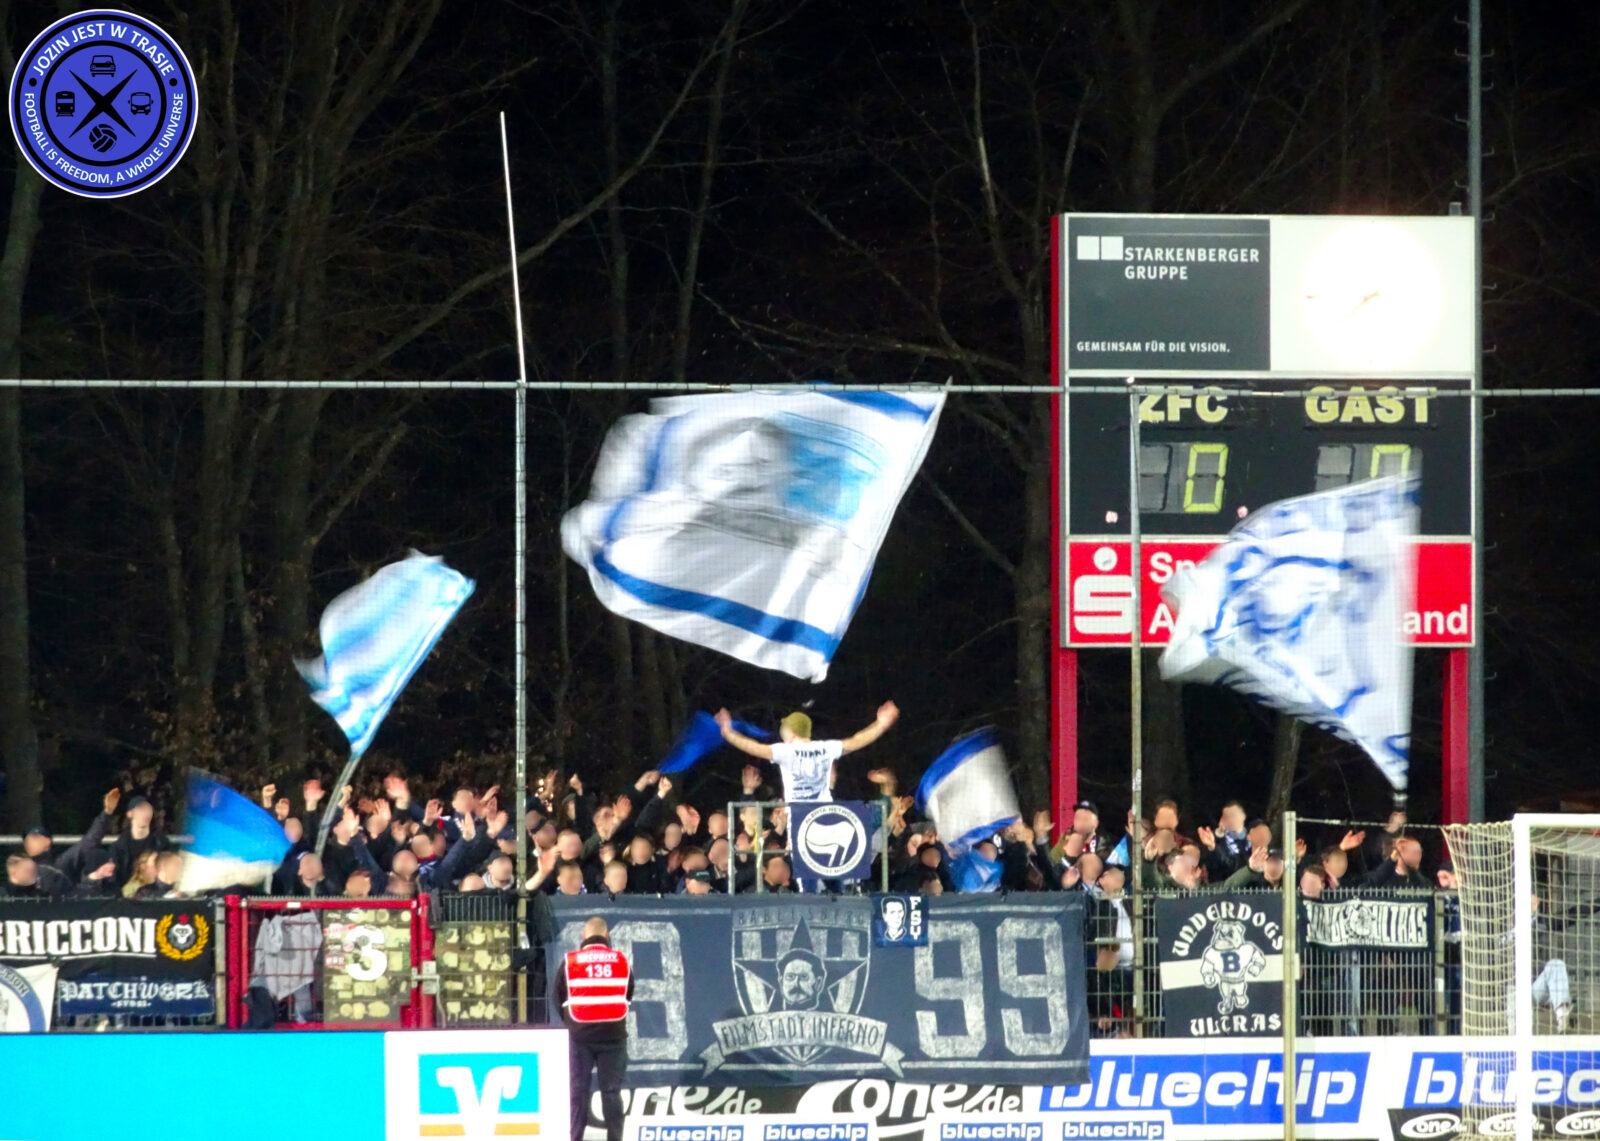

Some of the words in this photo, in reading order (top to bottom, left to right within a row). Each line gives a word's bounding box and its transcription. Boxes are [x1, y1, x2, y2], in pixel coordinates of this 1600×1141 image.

[1124, 247, 1260, 264] STARKENBERGER
[1124, 265, 1188, 280] GRUPPE
[1077, 341, 1142, 352] GEMEINSAM
[1145, 340, 1166, 353] FÜR
[1169, 342, 1186, 353] DIE
[1189, 342, 1231, 353] VISION.
[1136, 386, 1228, 424] ZFC
[1304, 385, 1438, 424] GAST
[1184, 443, 1229, 513] 0
[1402, 603, 1468, 635] and
[0, 917, 158, 955] RICCONI
[1172, 901, 1283, 957] UNDERDOGS
[347, 925, 387, 981] 3
[1221, 952, 1241, 973] B
[586, 964, 612, 977] 136
[721, 1016, 804, 1049] FILMSTADT
[812, 1016, 879, 1047] INFERNO
[1190, 1013, 1282, 1036] ULTRAS
[640, 1126, 743, 1141] bluechip
[766, 1124, 867, 1140] bluechip
[942, 1124, 1041, 1140] bluechip
[1064, 1122, 1163, 1138] bluechip
